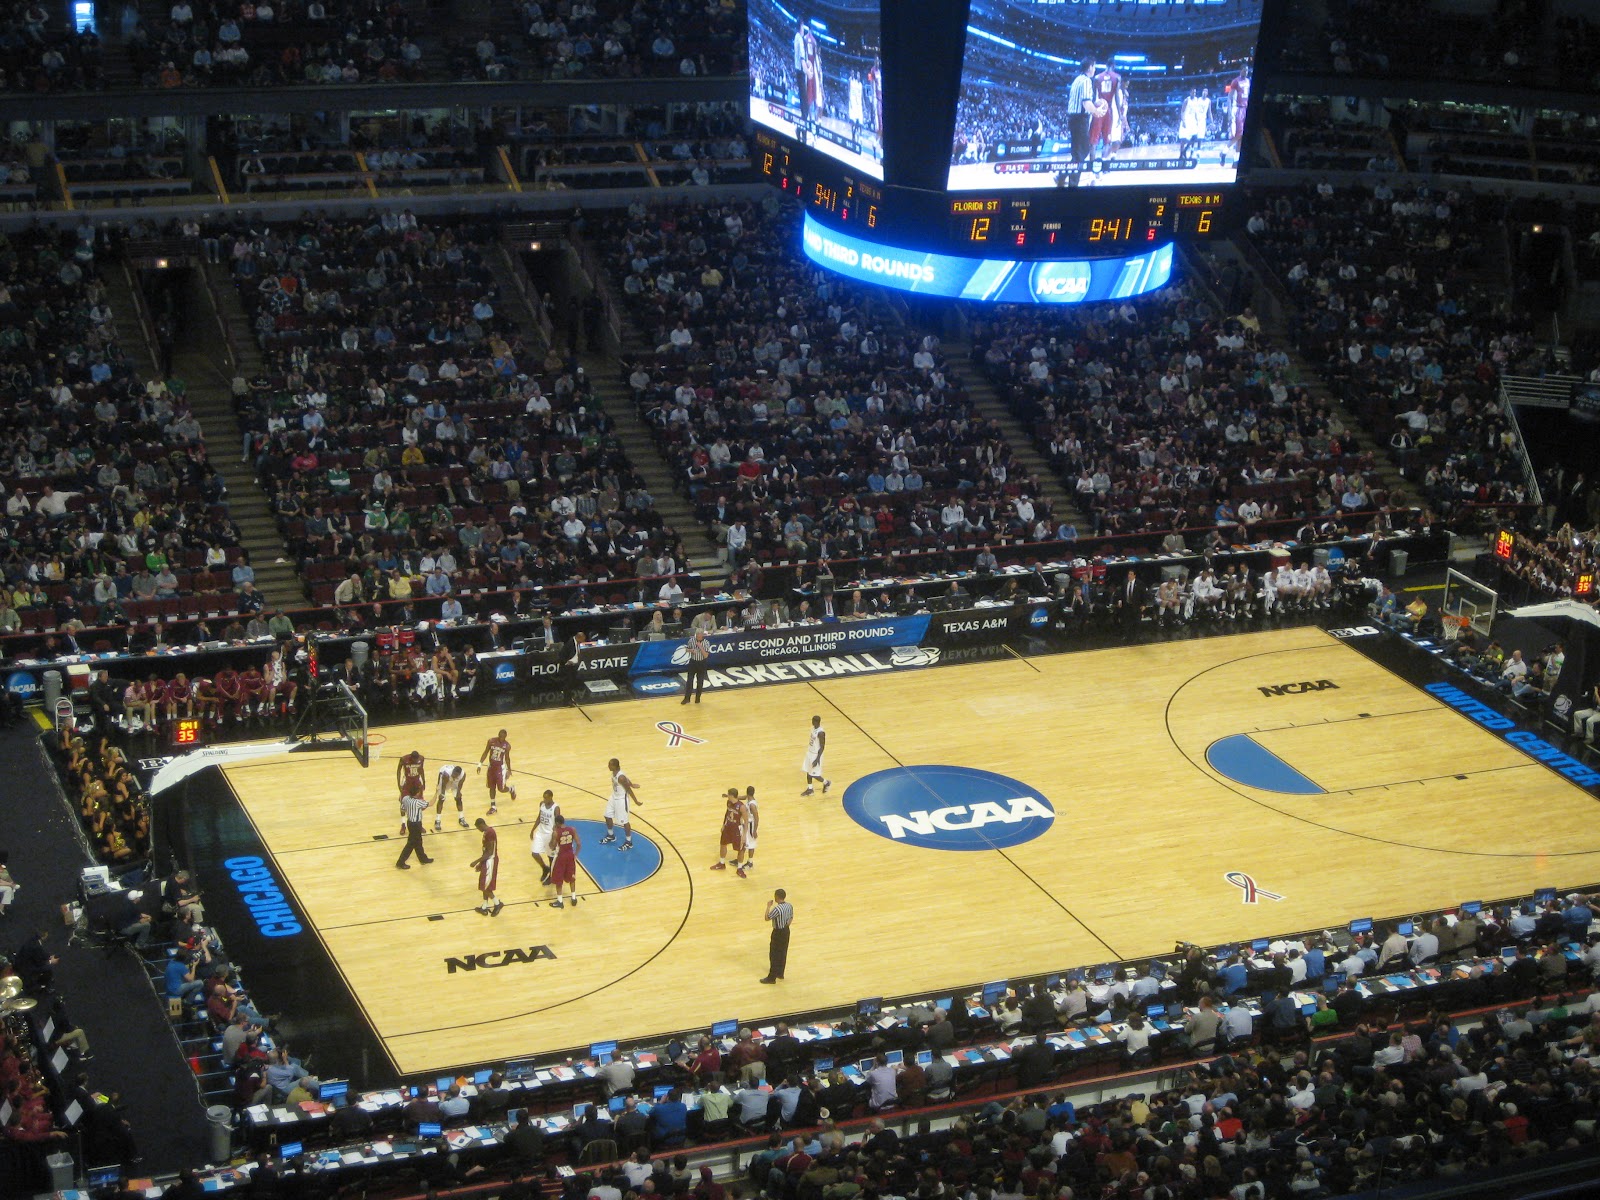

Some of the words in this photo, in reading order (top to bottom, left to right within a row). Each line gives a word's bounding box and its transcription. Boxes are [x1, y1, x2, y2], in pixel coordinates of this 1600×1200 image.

[847, 187, 853, 197] 2
[953, 202, 983, 211] FLORIDA
[987, 201, 998, 210] ST
[1180, 195, 1202, 204] TEXAS
[1213, 195, 1219, 203] M
[842, 208, 848, 219] 5
[868, 205, 877, 228] 6
[1021, 209, 1027, 220] 7
[1156, 205, 1164, 216] 2
[1198, 211, 1212, 233] 6
[970, 218, 990, 240] 12
[1089, 218, 1132, 240] 9:41
[1147, 229, 1155, 240] 5
[1016, 233, 1025, 244] 5
[1050, 232, 1055, 243] 1
[823, 237, 859, 267] THIRD
[861, 252, 935, 282] ROUNDS
[1036, 277, 1087, 295] NCAA
[1497, 540, 1511, 558] 35
[1577, 582, 1589, 592] 35
[943, 620, 979, 633] TEXAS
[982, 617, 1008, 630] A&M
[1030, 616, 1048, 624] NCAA
[708, 642, 734, 655] CAA
[738, 637, 784, 652] SECOND
[786, 634, 811, 647] AND
[813, 631, 846, 644] THIRD
[848, 626, 895, 640] ROUNDS
[760, 646, 801, 657] CHICAGO,
[802, 642, 837, 653] ILLINOIS
[590, 656, 628, 670] STATE
[496, 670, 515, 680] NCAA
[641, 681, 680, 691] NCAA
[1258, 679, 1340, 698] NCAA
[178, 730, 194, 743] 35
[1424, 681, 1516, 730] UNITED
[1504, 731, 1600, 787] CENTER
[202, 748, 228, 757] SPALDING
[880, 796, 1055, 839] NCAA
[559, 834, 573, 845] 22
[224, 856, 303, 937] CHICAGO
[444, 944, 557, 974] NCAA
